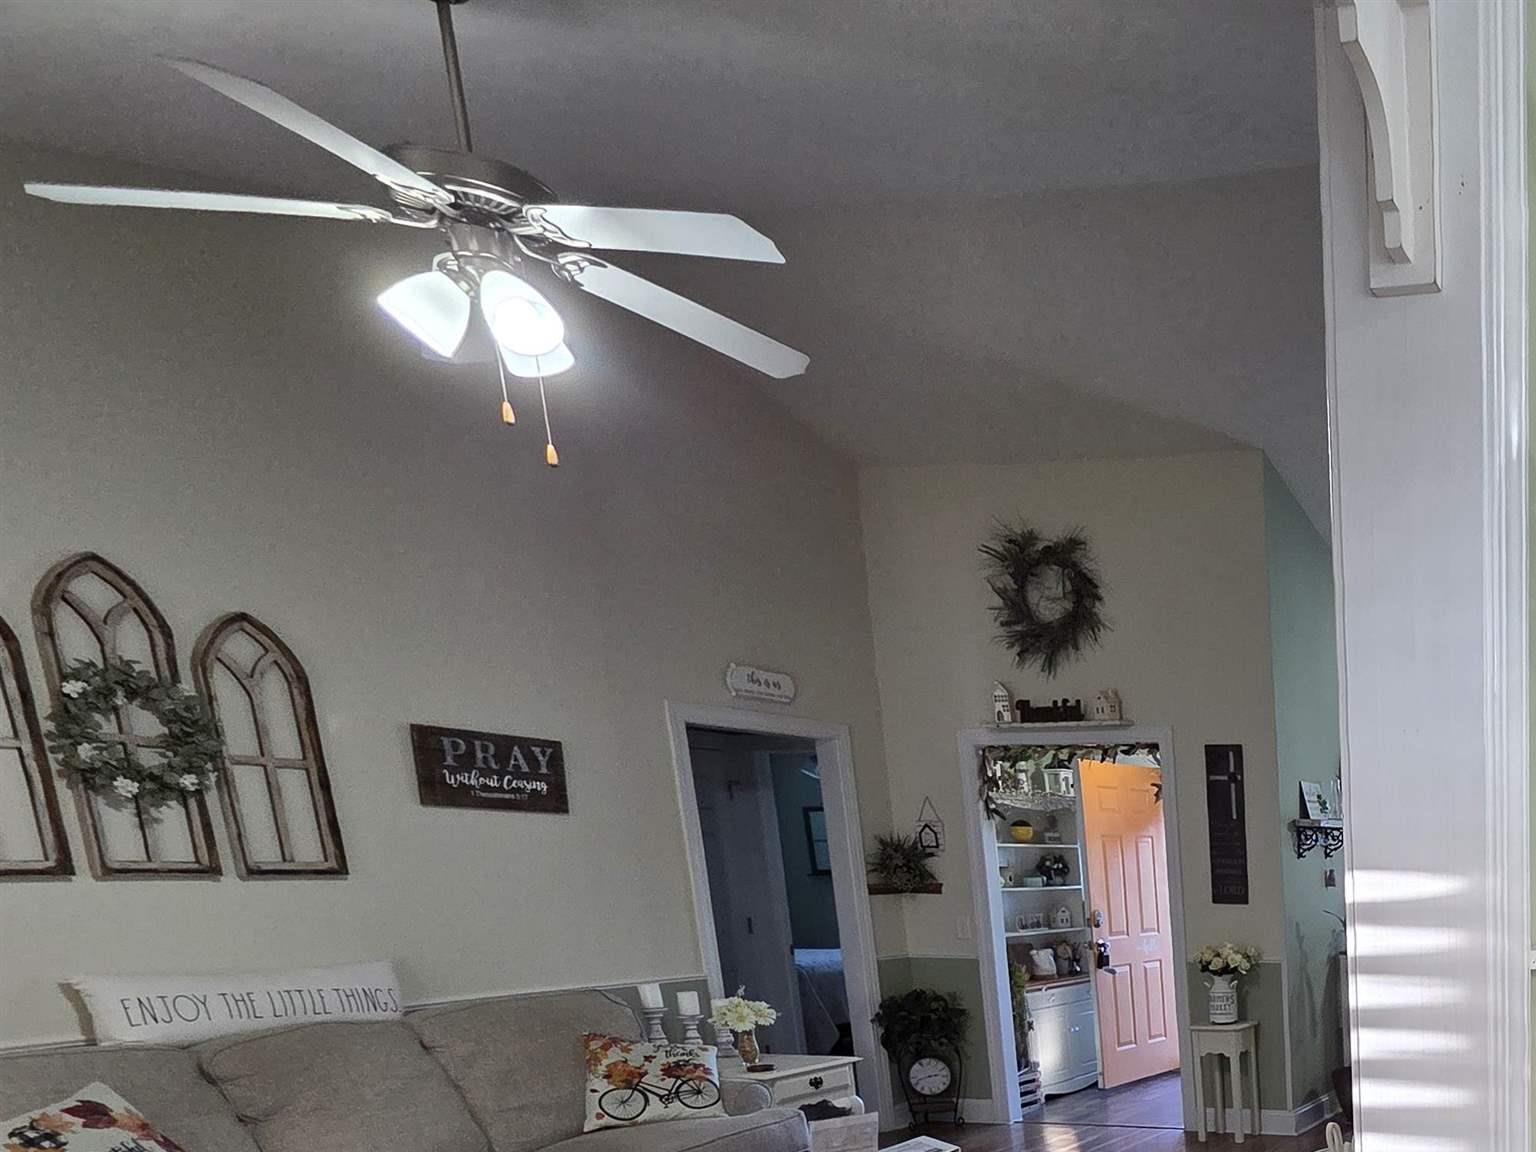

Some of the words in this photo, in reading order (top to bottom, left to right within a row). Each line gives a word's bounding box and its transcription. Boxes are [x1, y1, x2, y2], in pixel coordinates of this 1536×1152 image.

[440, 736, 553, 774] PRAY
[443, 769, 501, 788] Without
[503, 775, 548, 795] Ceasing
[120, 994, 212, 1027] ENJOY
[218, 991, 263, 1019] THE
[266, 987, 331, 1017] LITTLE
